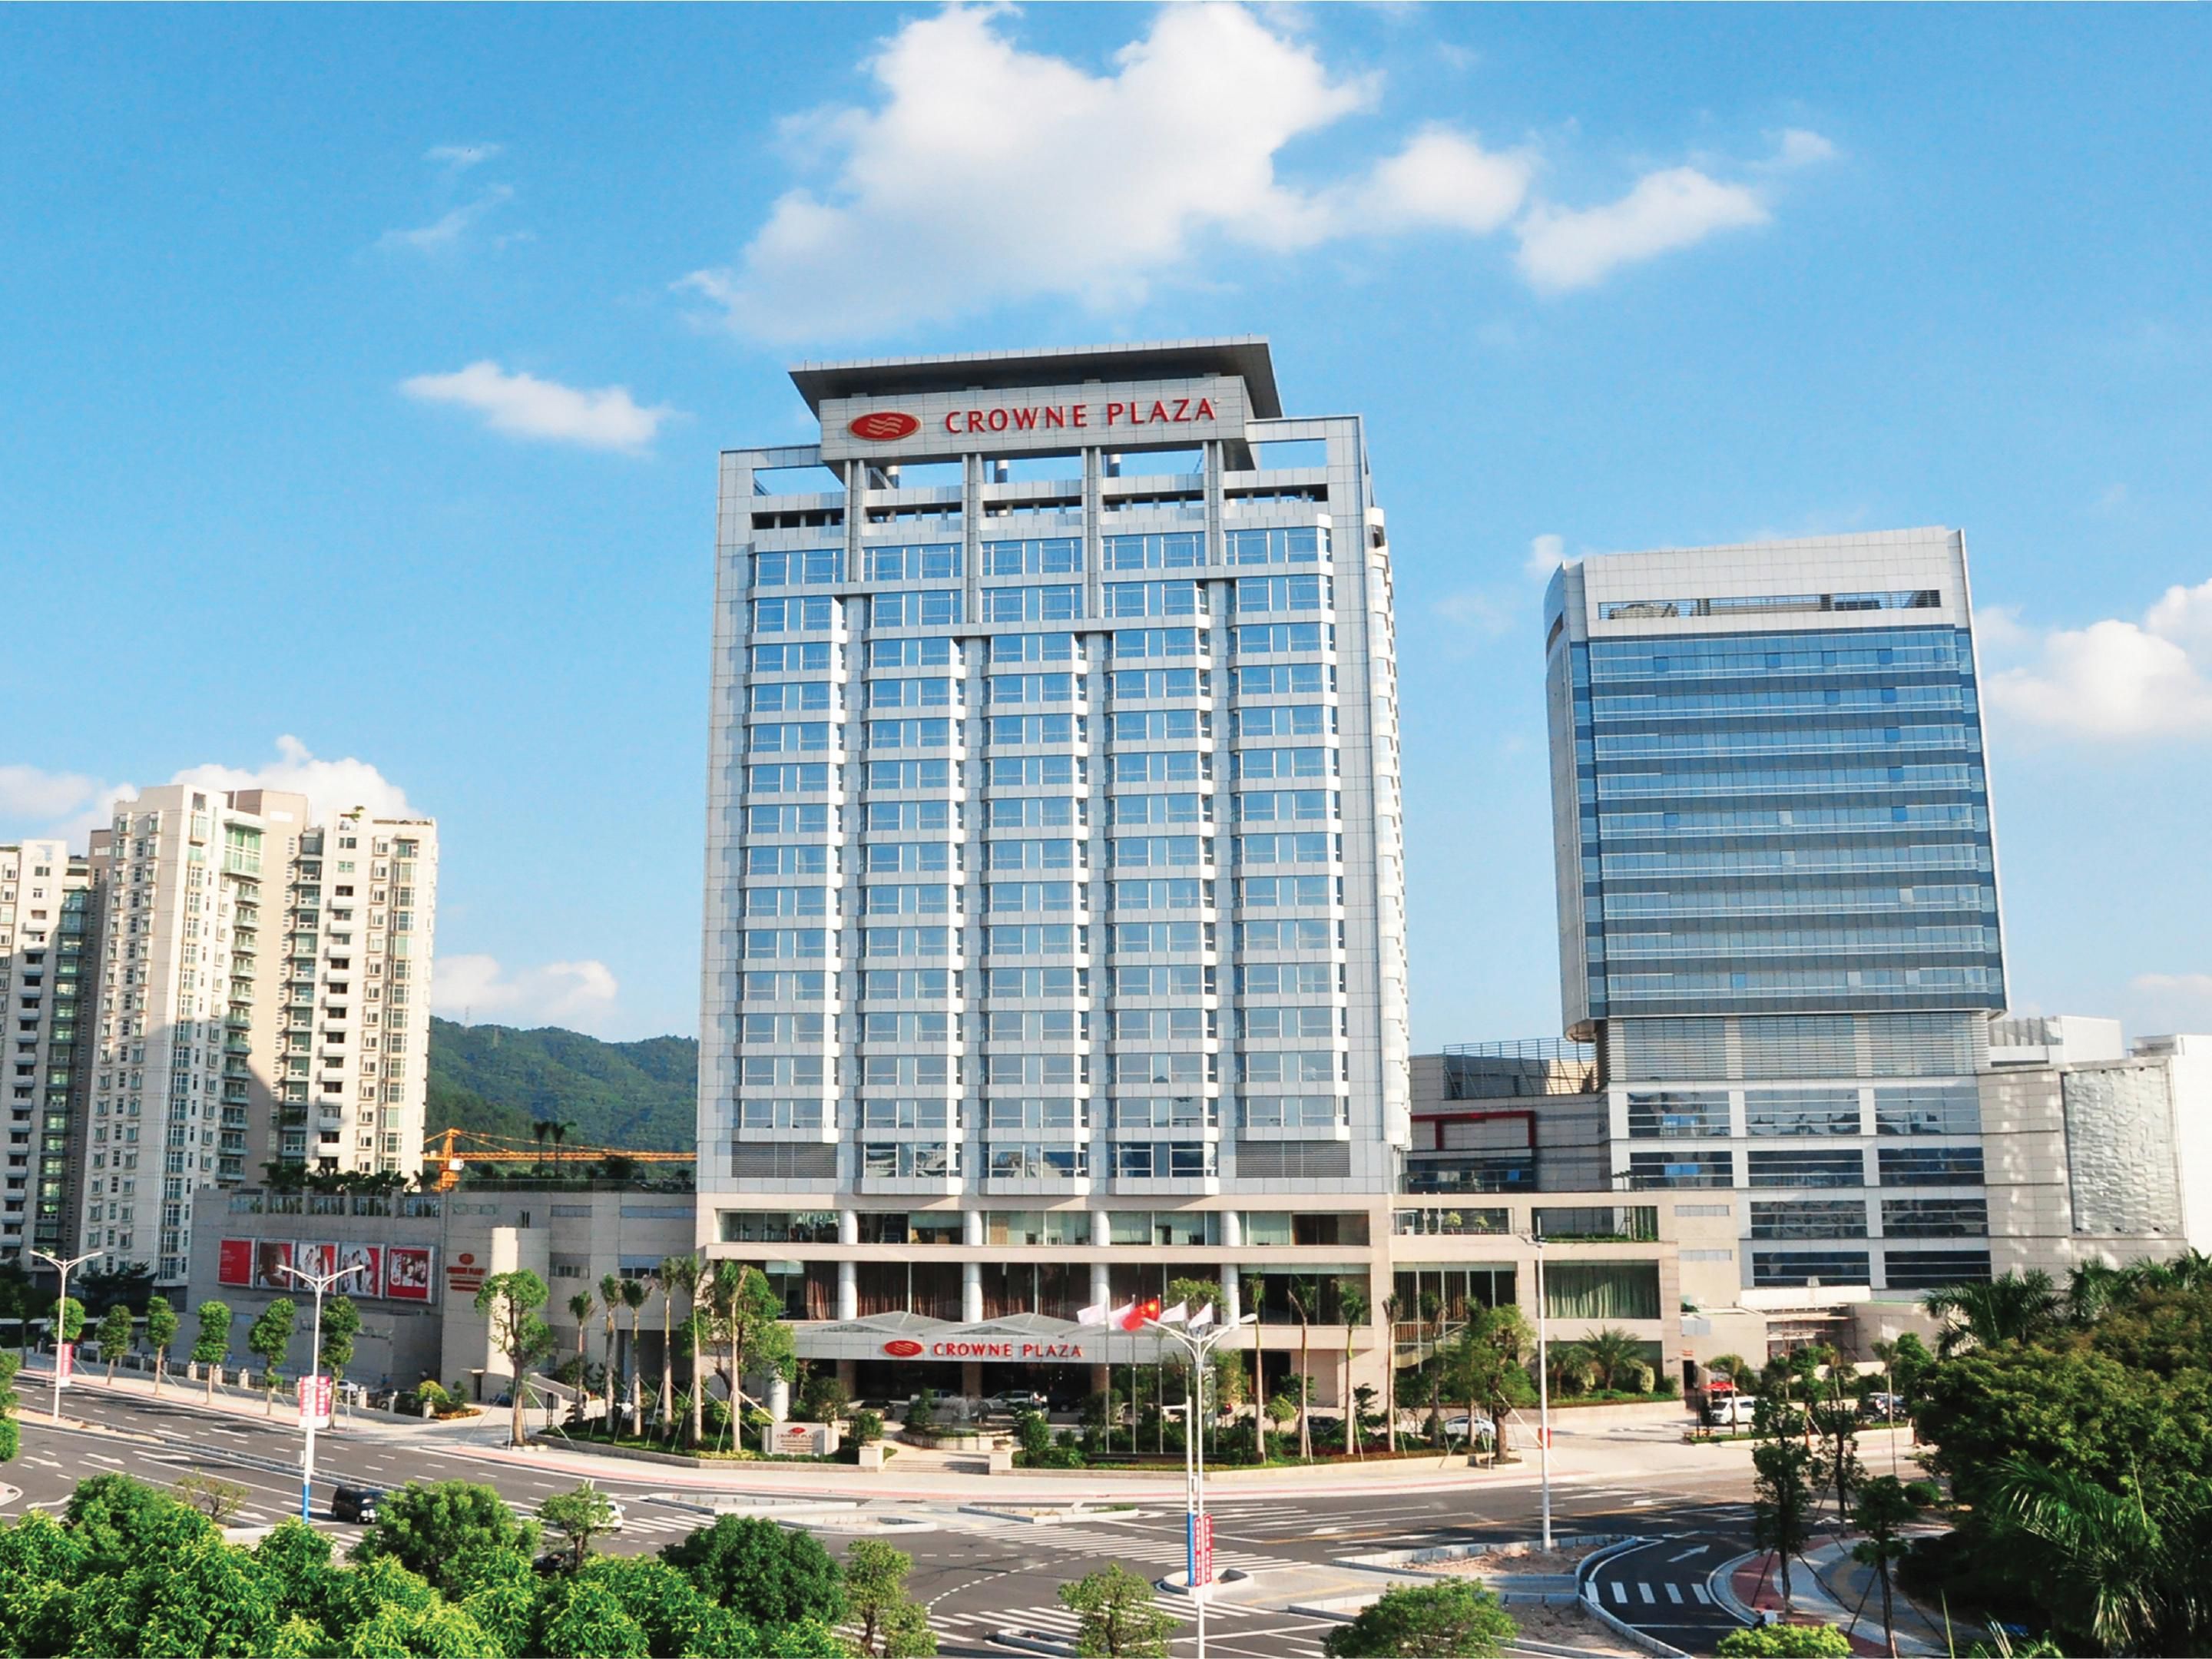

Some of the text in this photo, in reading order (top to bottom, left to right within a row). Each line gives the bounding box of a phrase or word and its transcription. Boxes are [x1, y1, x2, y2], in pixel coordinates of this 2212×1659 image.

[945, 398, 1215, 433] CROWNE PLAZA
[934, 1343, 1082, 1357] CROWNE PLAZA
